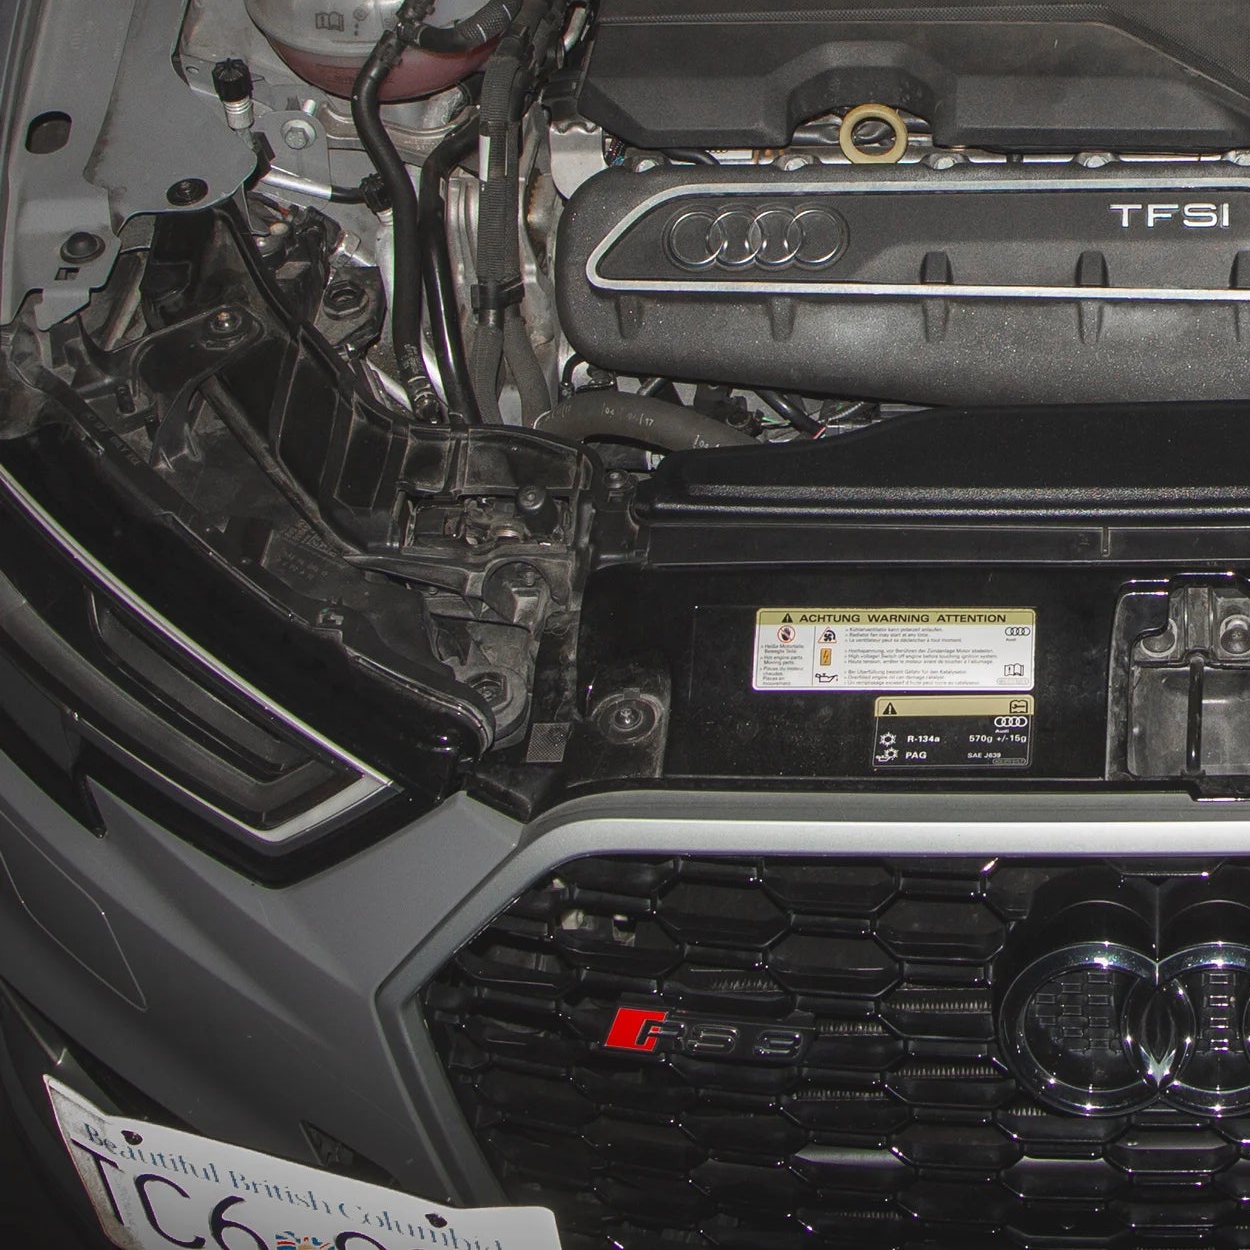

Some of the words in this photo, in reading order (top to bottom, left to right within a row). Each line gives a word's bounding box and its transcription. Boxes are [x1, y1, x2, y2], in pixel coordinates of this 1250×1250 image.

[1109, 202, 1231, 228] TFSI
[799, 613, 861, 623] ACHTUNG
[868, 613, 930, 623] WARNING
[937, 613, 1006, 623] ATTENTION
[907, 735, 941, 743] R-134a
[969, 734, 993, 744] 570g
[905, 751, 927, 760] PAG
[84, 1123, 219, 1183] Beautiful
[228, 1170, 331, 1215] British
